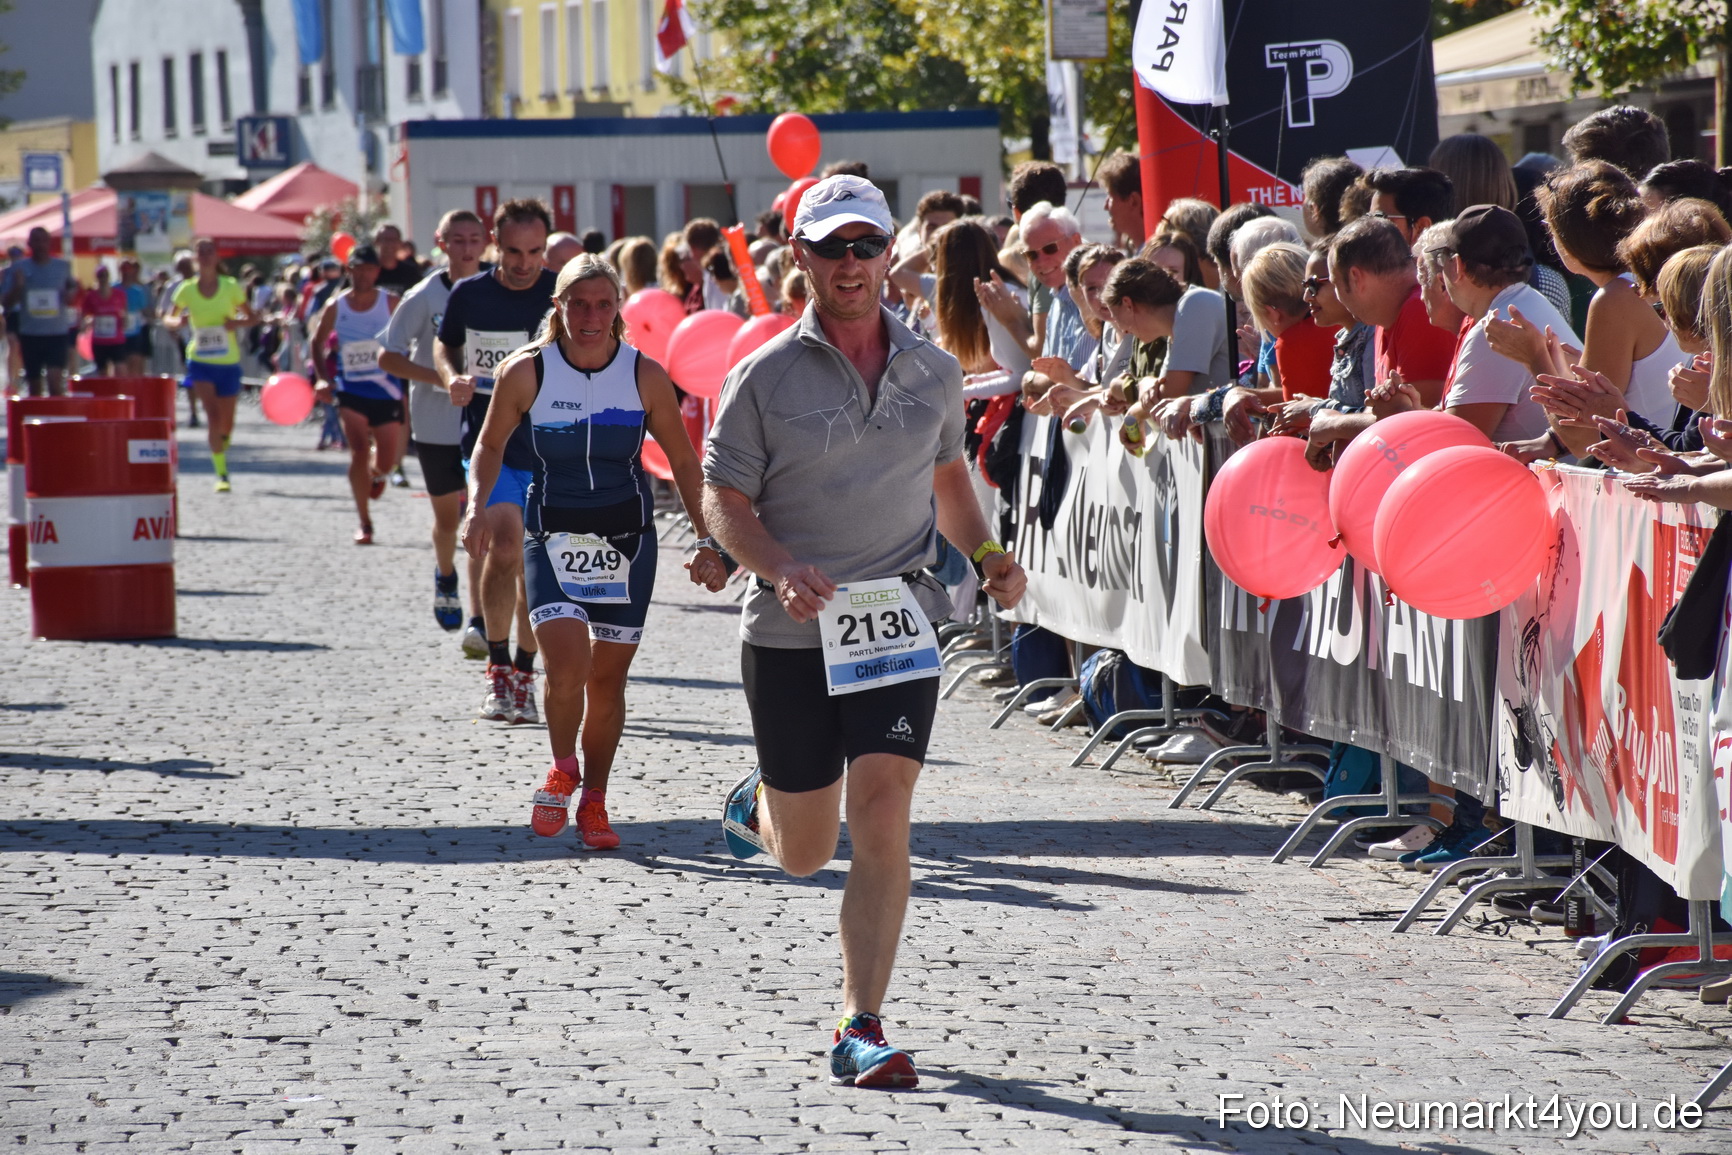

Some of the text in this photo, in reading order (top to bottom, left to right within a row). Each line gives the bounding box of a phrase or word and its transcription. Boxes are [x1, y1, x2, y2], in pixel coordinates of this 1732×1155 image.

[1272, 51, 1298, 60] Team
[1247, 185, 1286, 205] THE
[475, 348, 516, 369] 239
[551, 400, 582, 409] ATSV
[561, 550, 621, 573] 2249
[581, 586, 607, 597] Ulrike
[850, 589, 901, 605] BOCK
[837, 608, 920, 647] 2130
[849, 643, 908, 658] PARTL Neumarkt
[855, 658, 915, 678] Christian
[1567, 900, 1578, 922] now
